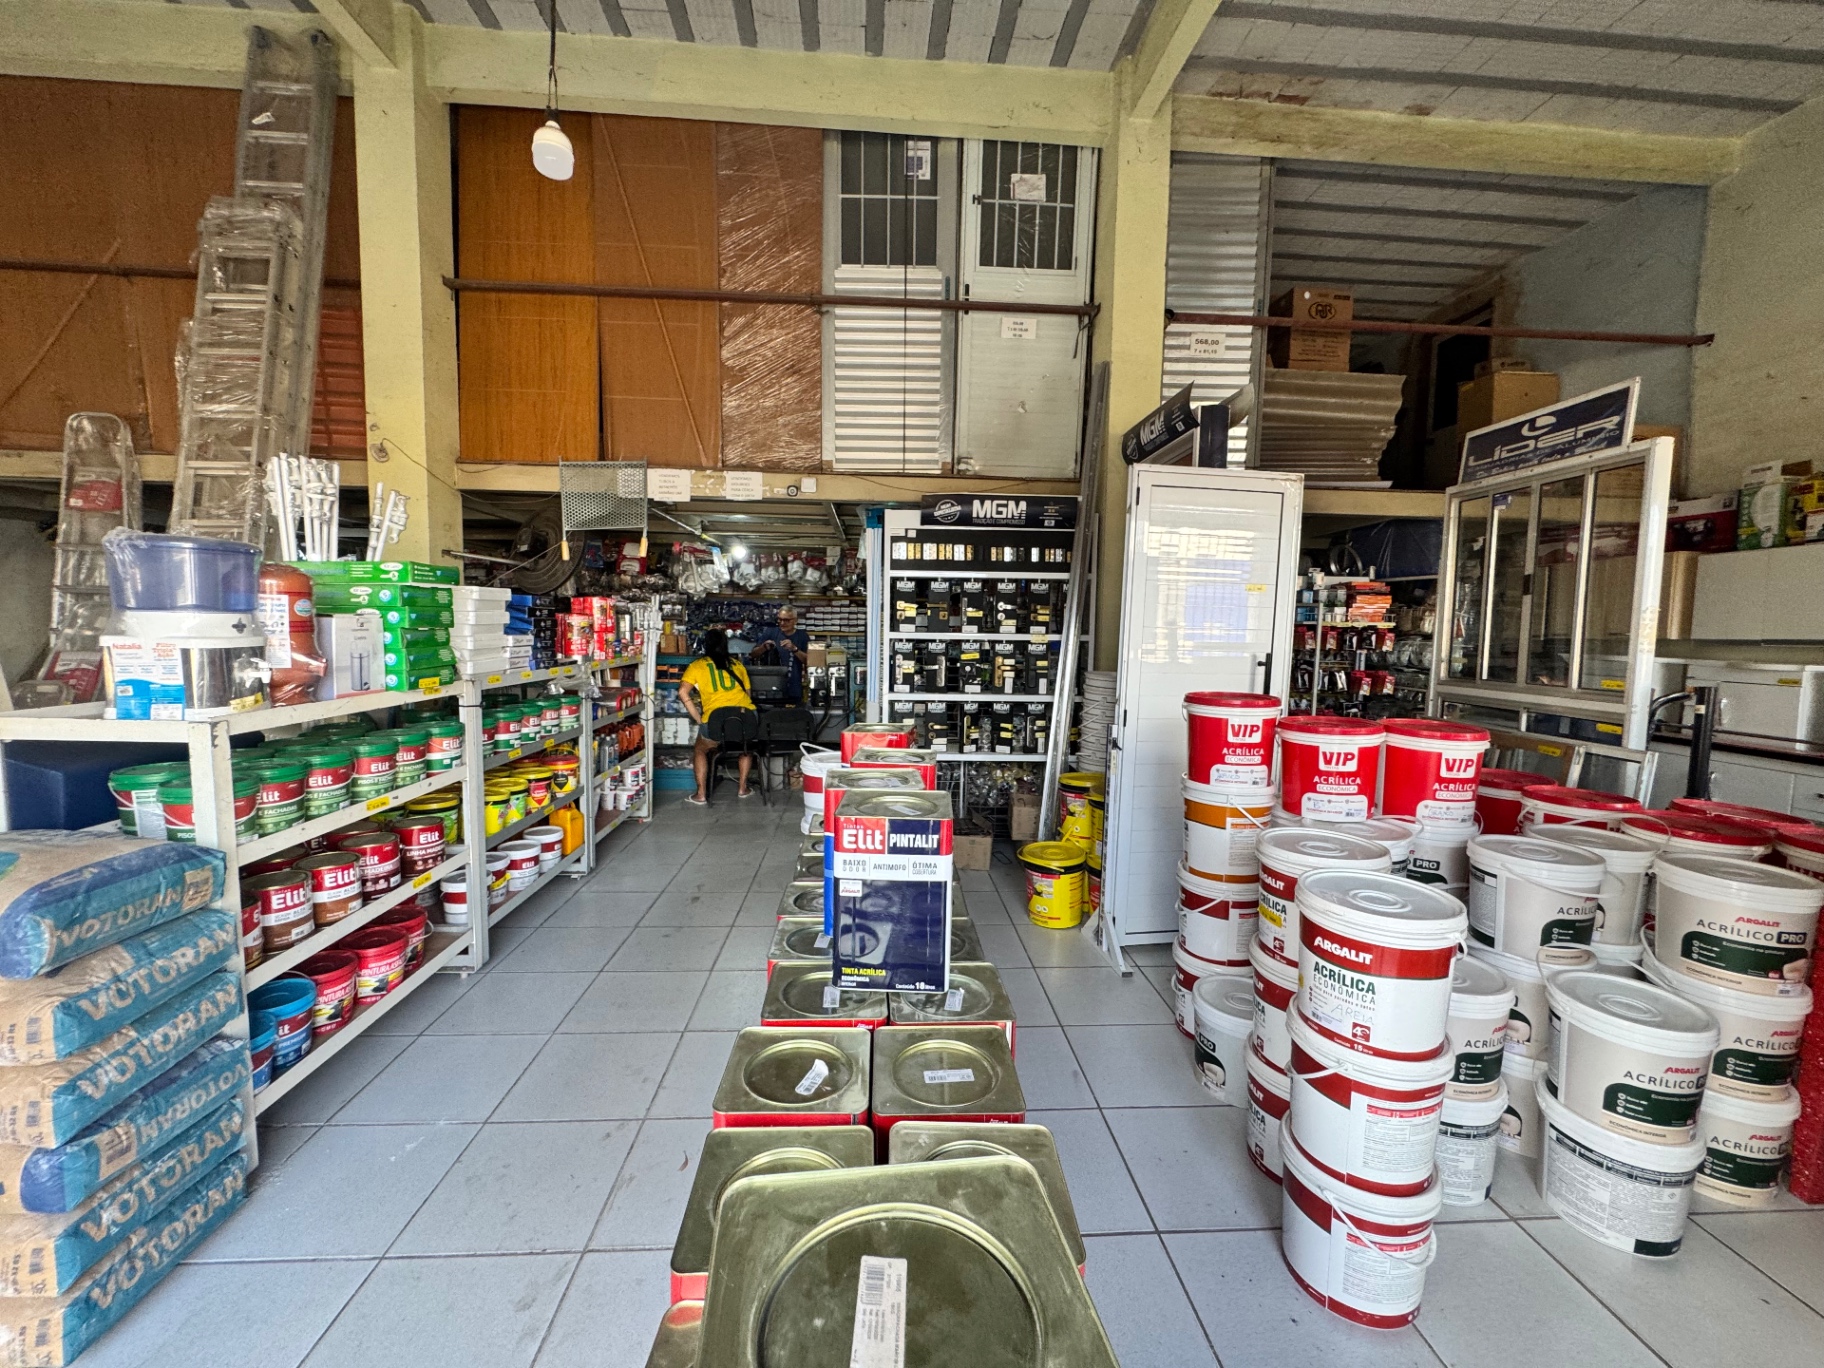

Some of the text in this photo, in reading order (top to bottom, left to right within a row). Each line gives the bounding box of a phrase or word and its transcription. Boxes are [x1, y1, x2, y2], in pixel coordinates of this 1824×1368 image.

[1194, 338, 1220, 346] 568,00
[1140, 410, 1165, 446] MGM
[972, 499, 1027, 519] MGM
[897, 581, 915, 589] MGM
[930, 581, 949, 589] MGM
[997, 582, 1016, 590] MGM
[895, 642, 913, 651] MGM
[928, 642, 946, 651] MGM
[962, 642, 980, 650] MGM
[995, 643, 1014, 651] MGM
[1028, 644, 1047, 652] MGM
[895, 702, 913, 710] MGM
[928, 702, 946, 710] MGM
[964, 703, 979, 711] MGM
[993, 703, 1011, 711] MGM
[1028, 703, 1045, 711] MGM
[1230, 724, 1260, 738] VIP
[442, 738, 462, 749] Elit
[396, 751, 415, 761] Elit
[1222, 746, 1265, 756] ACRÍLICA
[1321, 751, 1356, 766] VIP
[370, 761, 390, 773] Elit
[1444, 758, 1475, 773] VIP
[308, 774, 333, 787] Elit
[1313, 775, 1362, 785] ACRÍLICA
[1432, 782, 1476, 791] ACRÍLICA
[264, 805, 298, 816] FACHADAS
[419, 831, 440, 844] Elit
[842, 829, 940, 850] Elit PINTALIT
[406, 849, 426, 857] LINHA
[360, 855, 379, 865] Elit
[1416, 860, 1437, 869] PRO
[873, 863, 907, 871] ANTIMOFO
[912, 861, 938, 869] ÓTIMA
[324, 869, 356, 888] Elit
[271, 887, 306, 910] Elit
[60, 886, 182, 948] VOTORAN
[1735, 916, 1781, 928] ARGALIT
[1696, 919, 1804, 943] ACRÍLICO PRO
[1314, 936, 1373, 965] ARGALIT
[77, 923, 236, 1021] VOTORAN
[361, 965, 389, 976] PINTURA
[841, 967, 886, 976] TINTA ACRÍLICA
[1313, 961, 1377, 995] ACRÍLICA
[1313, 974, 1376, 1006] ECONÔMICA
[1331, 1003, 1375, 1026] AREIA
[78, 984, 237, 1100] VOTORAN
[1200, 1036, 1214, 1050] PRO
[1353, 1043, 1363, 1051] 15
[1733, 1036, 1796, 1051] ACRÍLICO
[1623, 1070, 1695, 1089] ACRÍLICO
[140, 1064, 247, 1144] VOTORAN
[1710, 1135, 1777, 1155] ACRÍLICO
[81, 1111, 241, 1242] VOTORAN
[90, 1168, 243, 1309] VOTORAN
